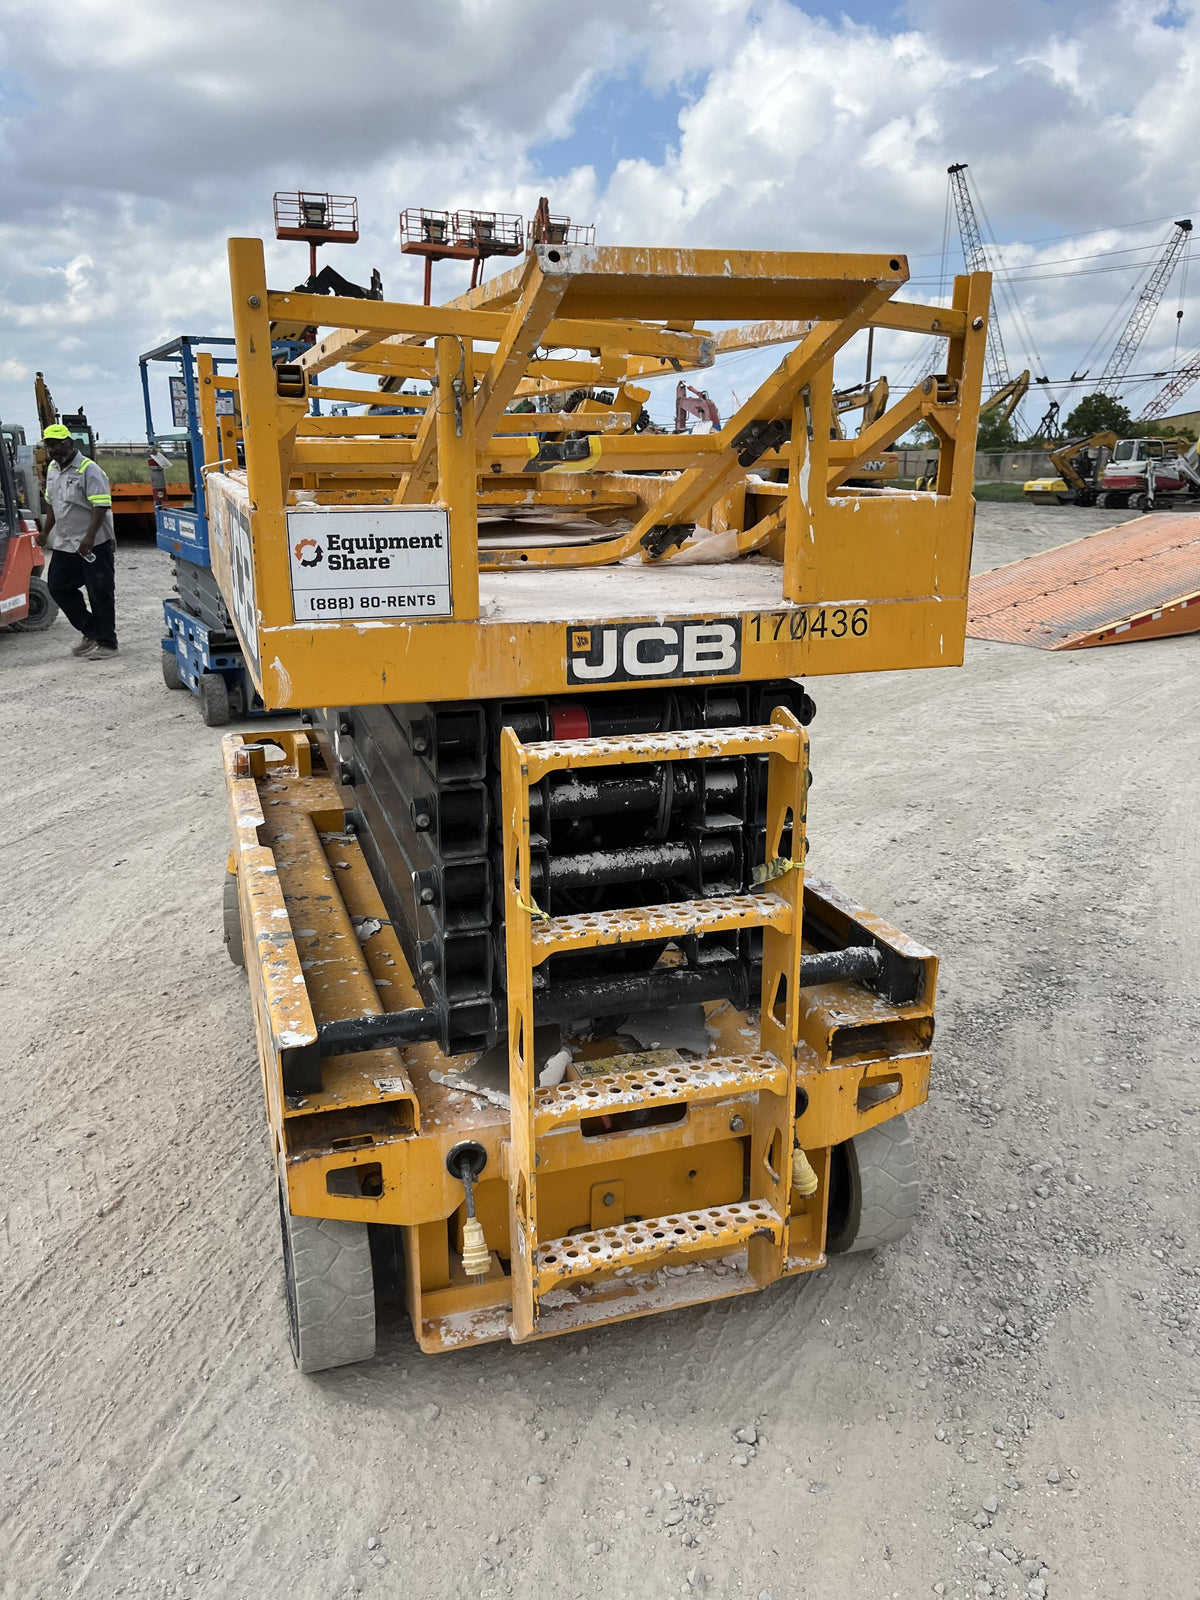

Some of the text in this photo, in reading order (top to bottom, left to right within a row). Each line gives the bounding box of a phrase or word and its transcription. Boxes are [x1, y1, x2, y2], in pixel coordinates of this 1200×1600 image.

[861, 460, 886, 471] ANY
[326, 533, 443, 553] Equipment
[328, 555, 390, 571] Share
[310, 594, 436, 611] (888) 80-RENTS
[749, 608, 869, 642] 170436
[572, 624, 737, 679] JCB
